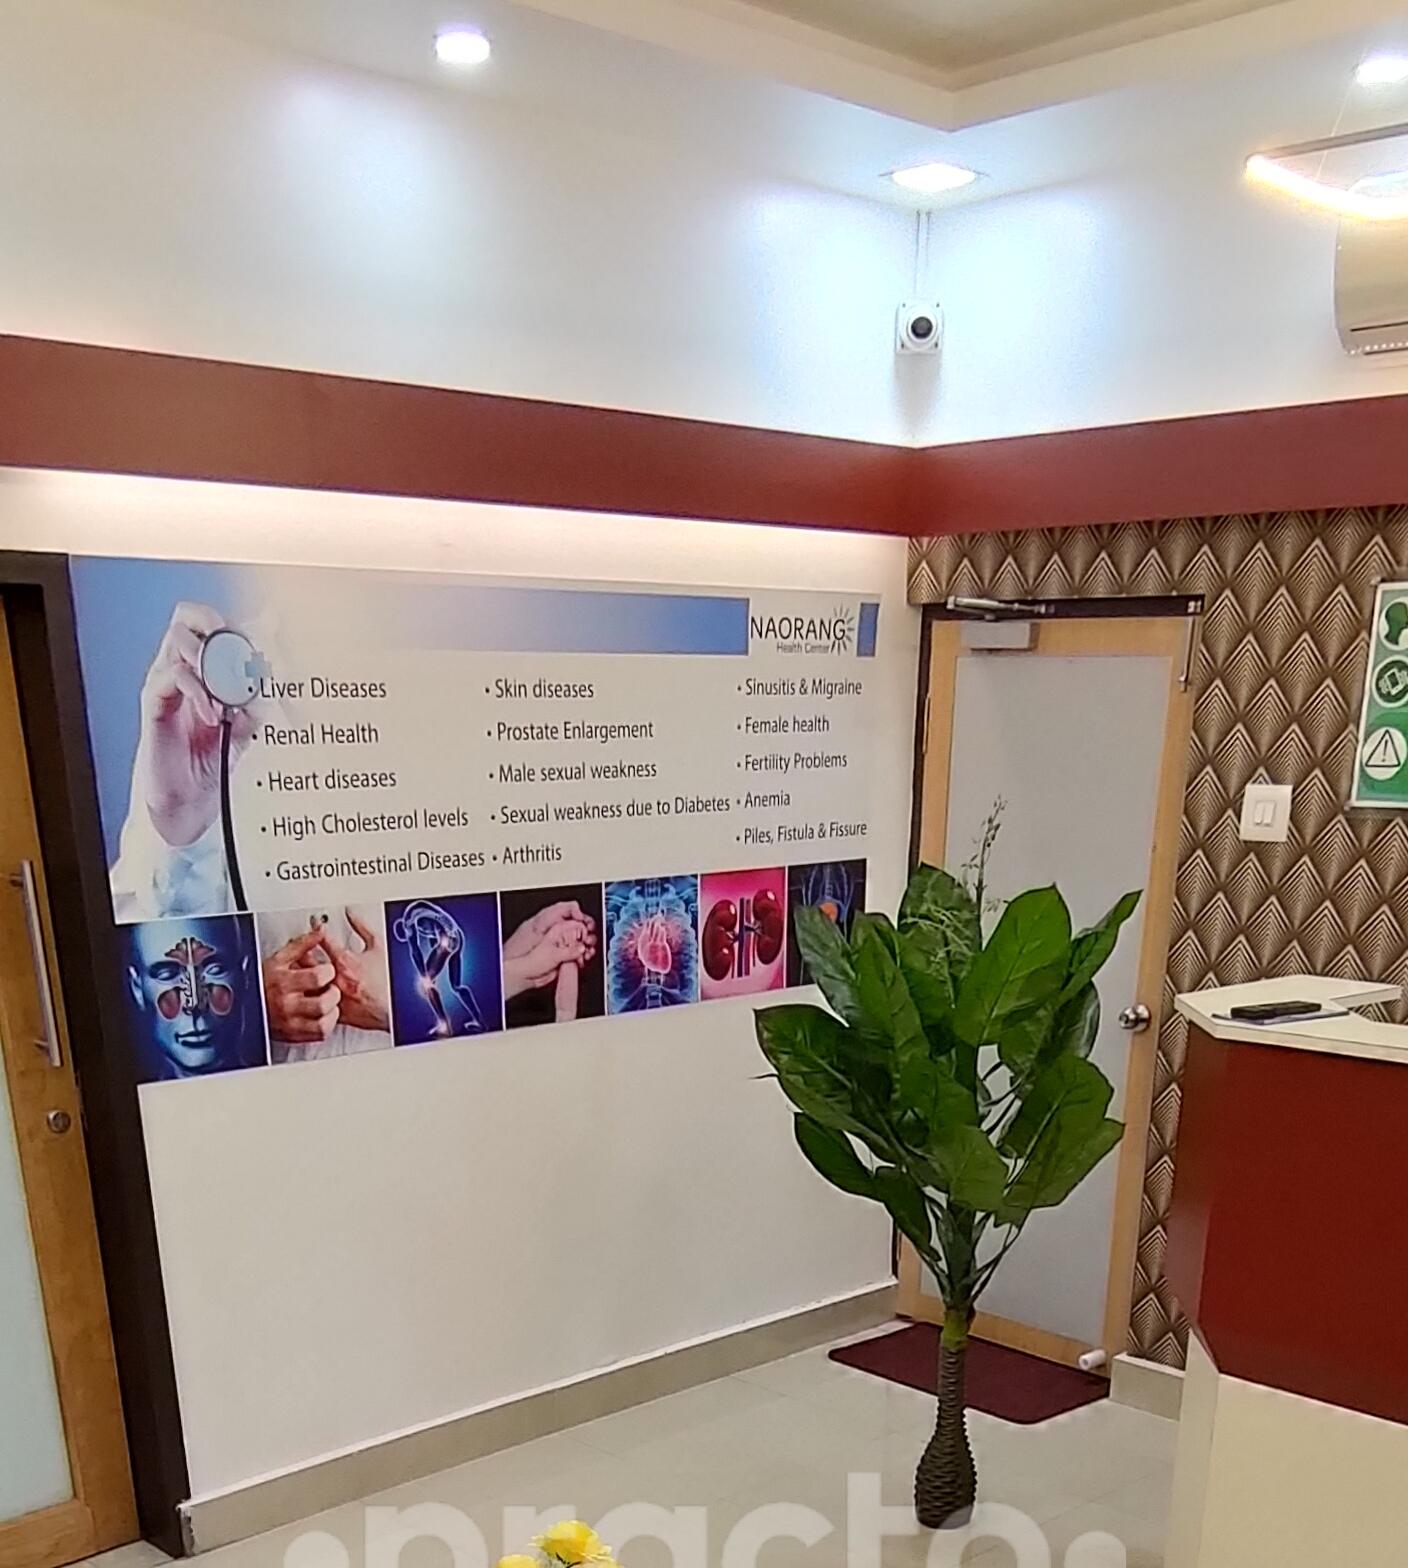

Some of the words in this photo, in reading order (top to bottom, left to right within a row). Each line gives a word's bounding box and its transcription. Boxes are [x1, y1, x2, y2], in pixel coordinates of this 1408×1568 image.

[750, 616, 846, 641] NAORANG
[776, 642, 802, 654] Health
[805, 643, 830, 654] Center
[260, 677, 304, 699] Liver
[311, 677, 387, 699] Diseases
[495, 678, 528, 699] Skin
[532, 678, 594, 699] diseases
[745, 678, 796, 696] Sinusitis
[799, 678, 809, 696] &
[812, 678, 863, 700] Migraine
[264, 723, 315, 745] Renal
[321, 722, 379, 744] Health
[497, 721, 559, 742] Prostate
[563, 720, 654, 744] Enlargement
[745, 716, 789, 734] Female
[793, 715, 830, 733] health
[499, 763, 536, 783] Male
[540, 762, 586, 781] sexual
[590, 760, 658, 779] weakness
[745, 754, 791, 774] Fertility
[794, 751, 848, 769] Problems
[268, 771, 320, 792] Heart
[324, 768, 397, 790] diseases
[500, 804, 549, 825] Sexual
[554, 801, 623, 821] weakness
[626, 798, 653, 817] due
[657, 799, 671, 815] to
[674, 796, 731, 815] Diabetes
[744, 790, 791, 809] Anemia
[272, 816, 316, 841] High
[321, 809, 418, 835] Cholesterol
[423, 806, 469, 829] levels
[744, 827, 774, 845] Piles,
[778, 824, 815, 843] Fistula
[818, 823, 827, 839] &
[829, 821, 868, 838] Fissure
[276, 852, 412, 881] Gastrointestinal
[417, 851, 485, 871] Diseases
[502, 844, 562, 865] Arthritis
